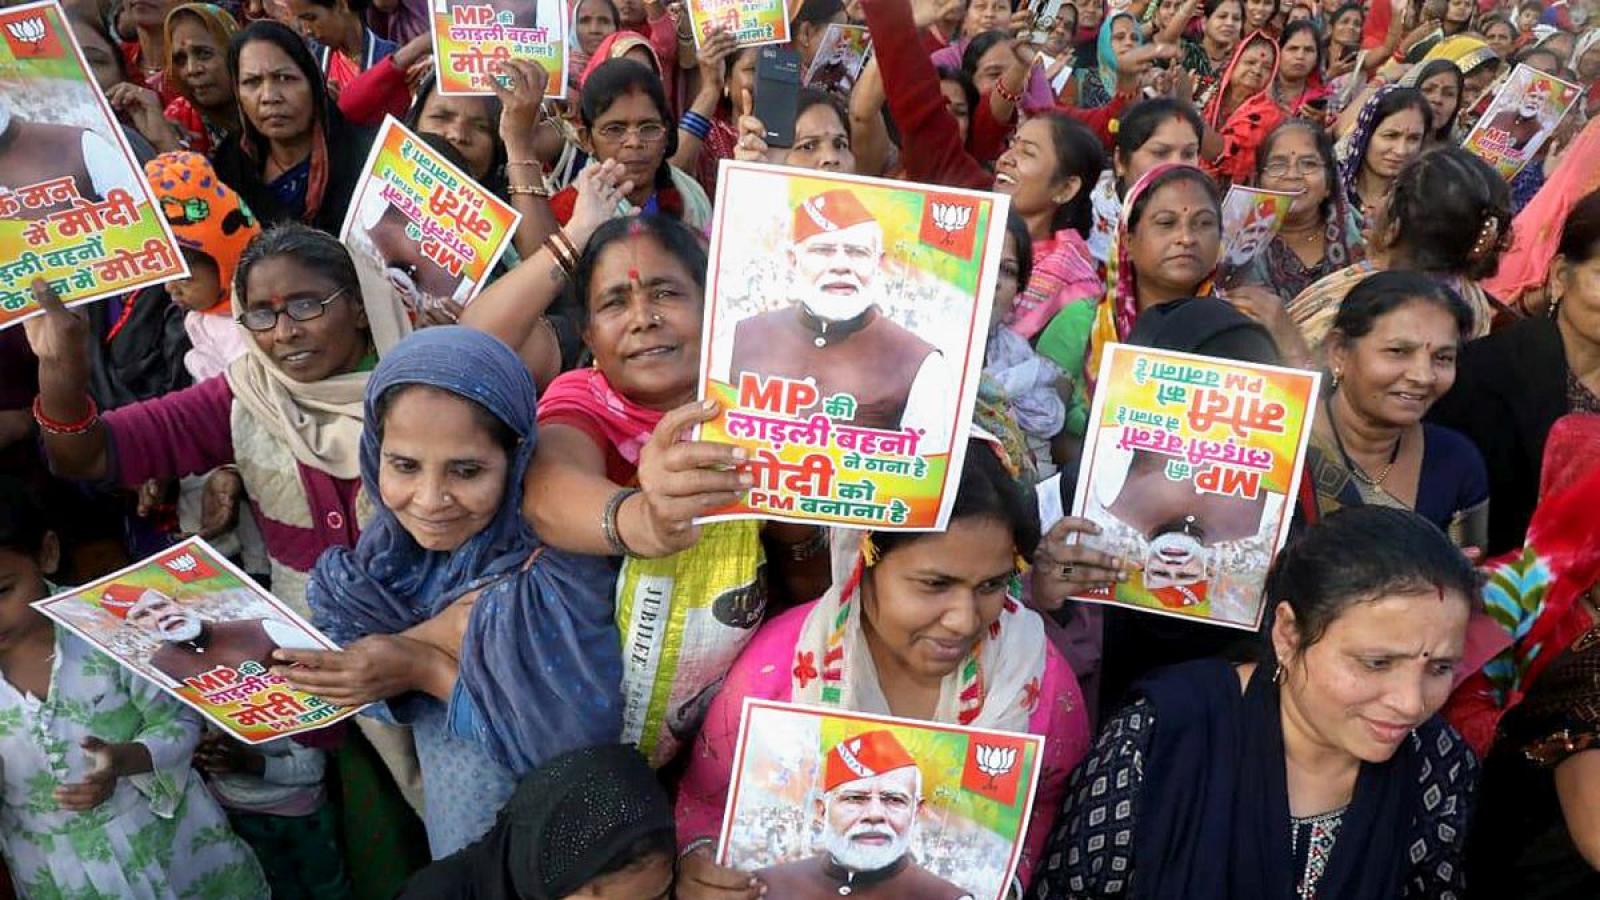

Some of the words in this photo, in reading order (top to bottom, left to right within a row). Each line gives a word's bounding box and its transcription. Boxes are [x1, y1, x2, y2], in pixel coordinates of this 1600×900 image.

[454, 7, 493, 24] MP
[451, 24, 504, 44] लाड़ली
[17, 182, 79, 207] मन
[459, 185, 484, 208] PM
[23, 221, 50, 245] में
[50, 189, 139, 236] मोदी
[429, 184, 492, 241] मोदी
[43, 236, 105, 267] बहनों
[422, 217, 474, 262] लाड़ली
[72, 267, 95, 288] में
[93, 240, 173, 281] मोदी
[423, 242, 462, 276] MP
[1151, 362, 1220, 387] बनाना
[1224, 374, 1263, 392] PM
[740, 375, 817, 414] MP
[824, 395, 854, 418] की
[1157, 384, 1186, 405] को
[1187, 389, 1285, 437] मोदी
[728, 412, 831, 450] लाड़ली
[836, 427, 926, 456] बहनों
[1117, 427, 1183, 453] बहनों
[844, 455, 860, 470] ने
[865, 456, 909, 474] ठाना
[913, 457, 927, 477] है
[1187, 438, 1271, 469] लाड़ली
[1167, 461, 1189, 478] की
[1196, 467, 1260, 498] MP
[838, 480, 875, 500] को
[751, 493, 793, 510] PM
[800, 497, 886, 520] बनाना
[890, 500, 907, 523] है
[632, 587, 663, 671] JUBILEE
[186, 668, 237, 693] MP
[227, 692, 307, 726] मोदी
